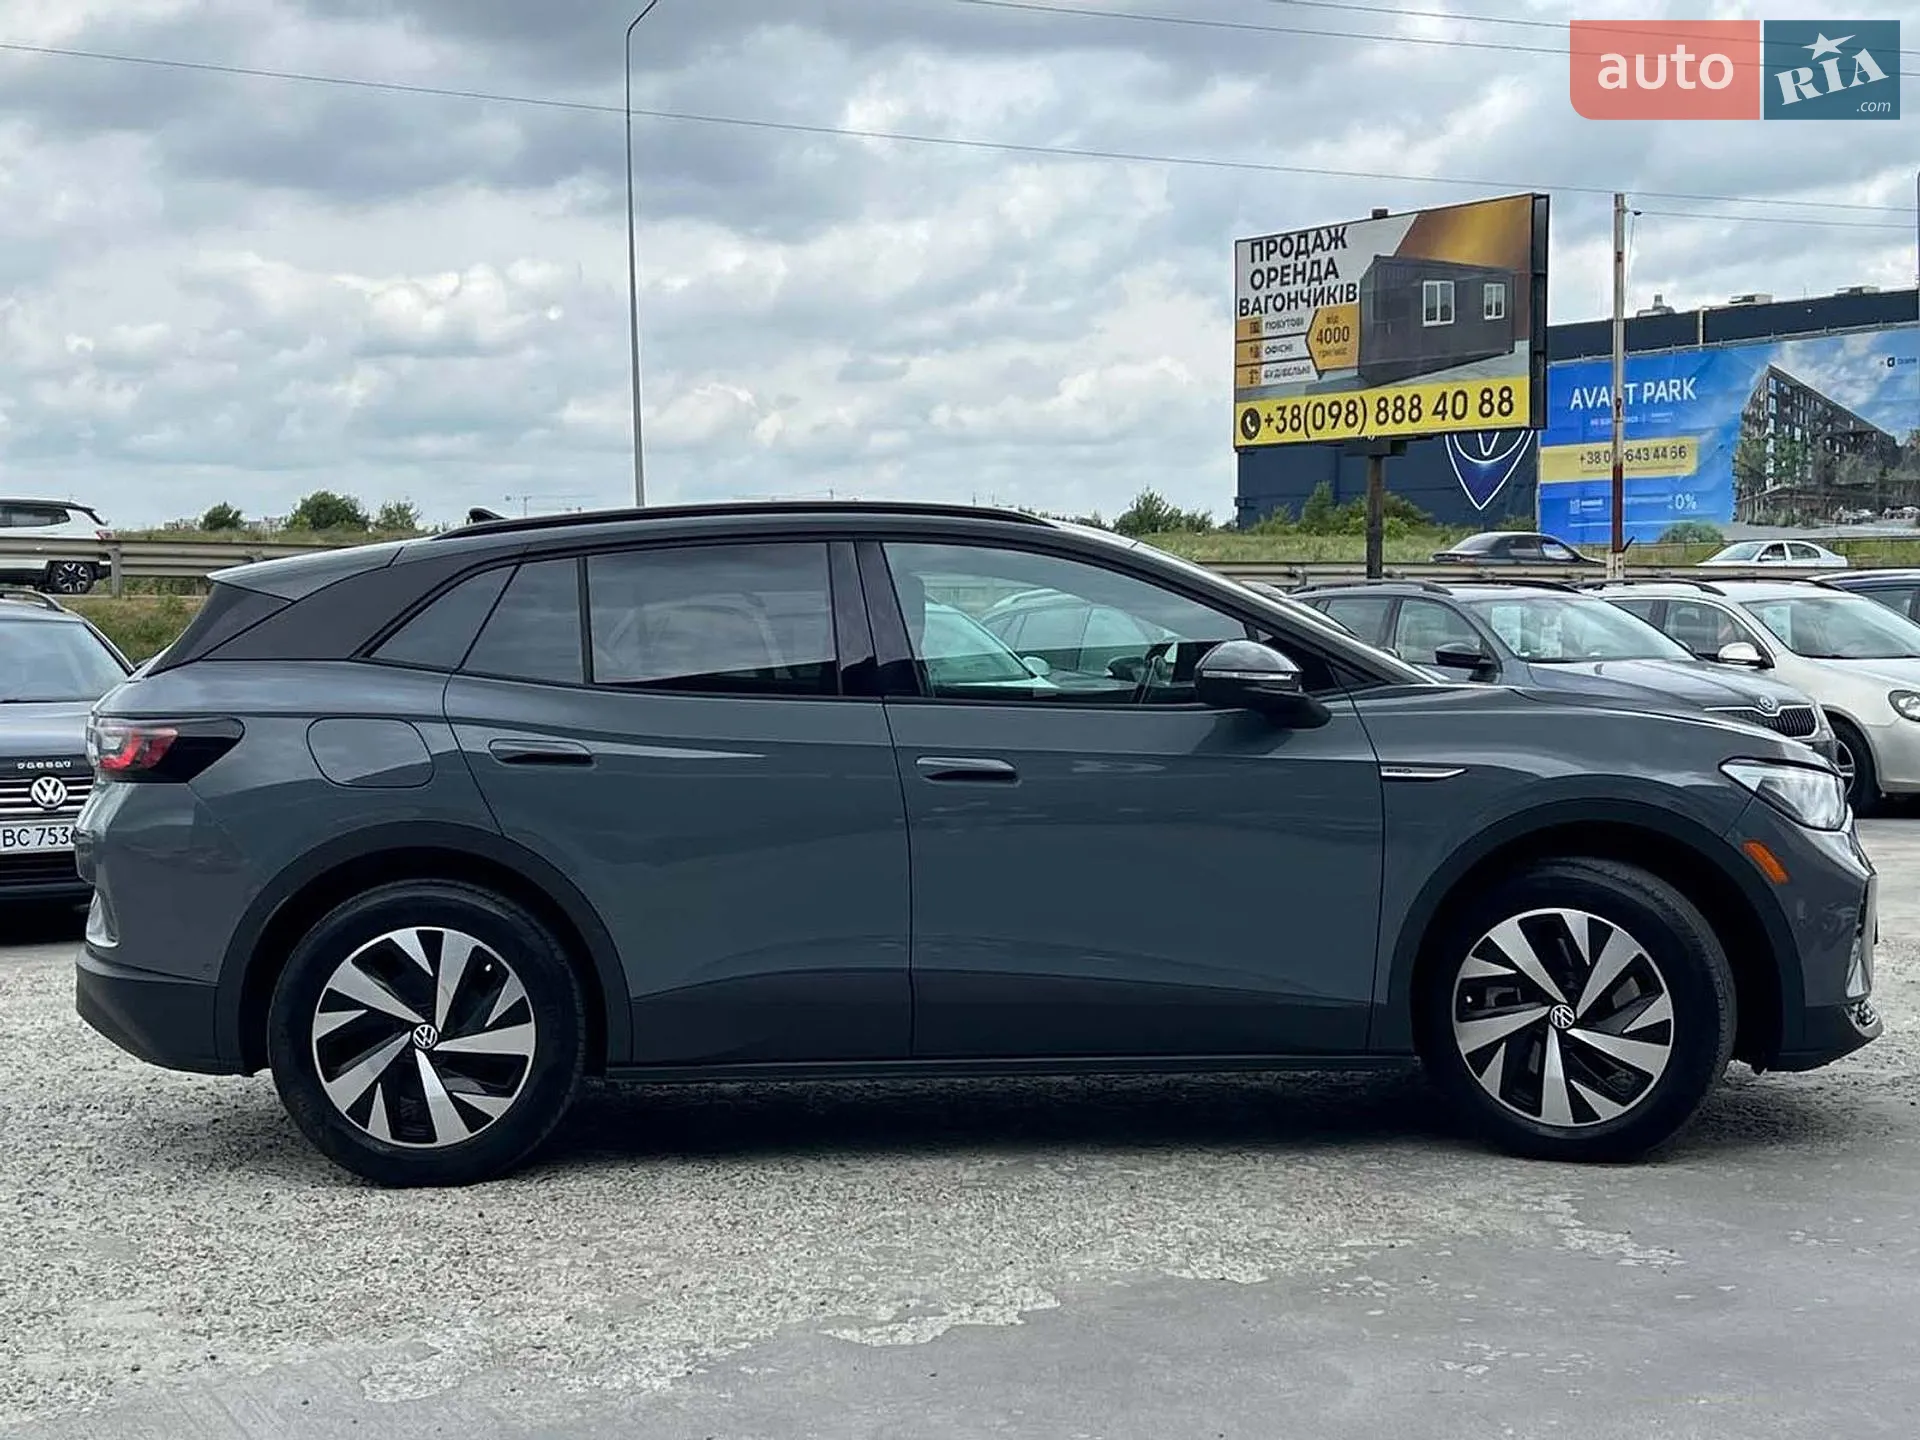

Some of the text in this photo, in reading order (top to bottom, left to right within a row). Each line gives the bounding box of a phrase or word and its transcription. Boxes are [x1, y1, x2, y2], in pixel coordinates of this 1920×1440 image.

[1250, 226, 1348, 263] ПРОДАЖ
[1250, 256, 1340, 291] ОРЕНДА
[1239, 283, 1357, 317] ВАГОНЧИКІВ
[1316, 326, 1350, 345] 4000
[1375, 393, 1422, 426] 888
[1432, 389, 1468, 421] 40
[1478, 386, 1514, 418] 88
[1570, 377, 1697, 411] AVAT PARK
[2, 826, 75, 847] BC 753
